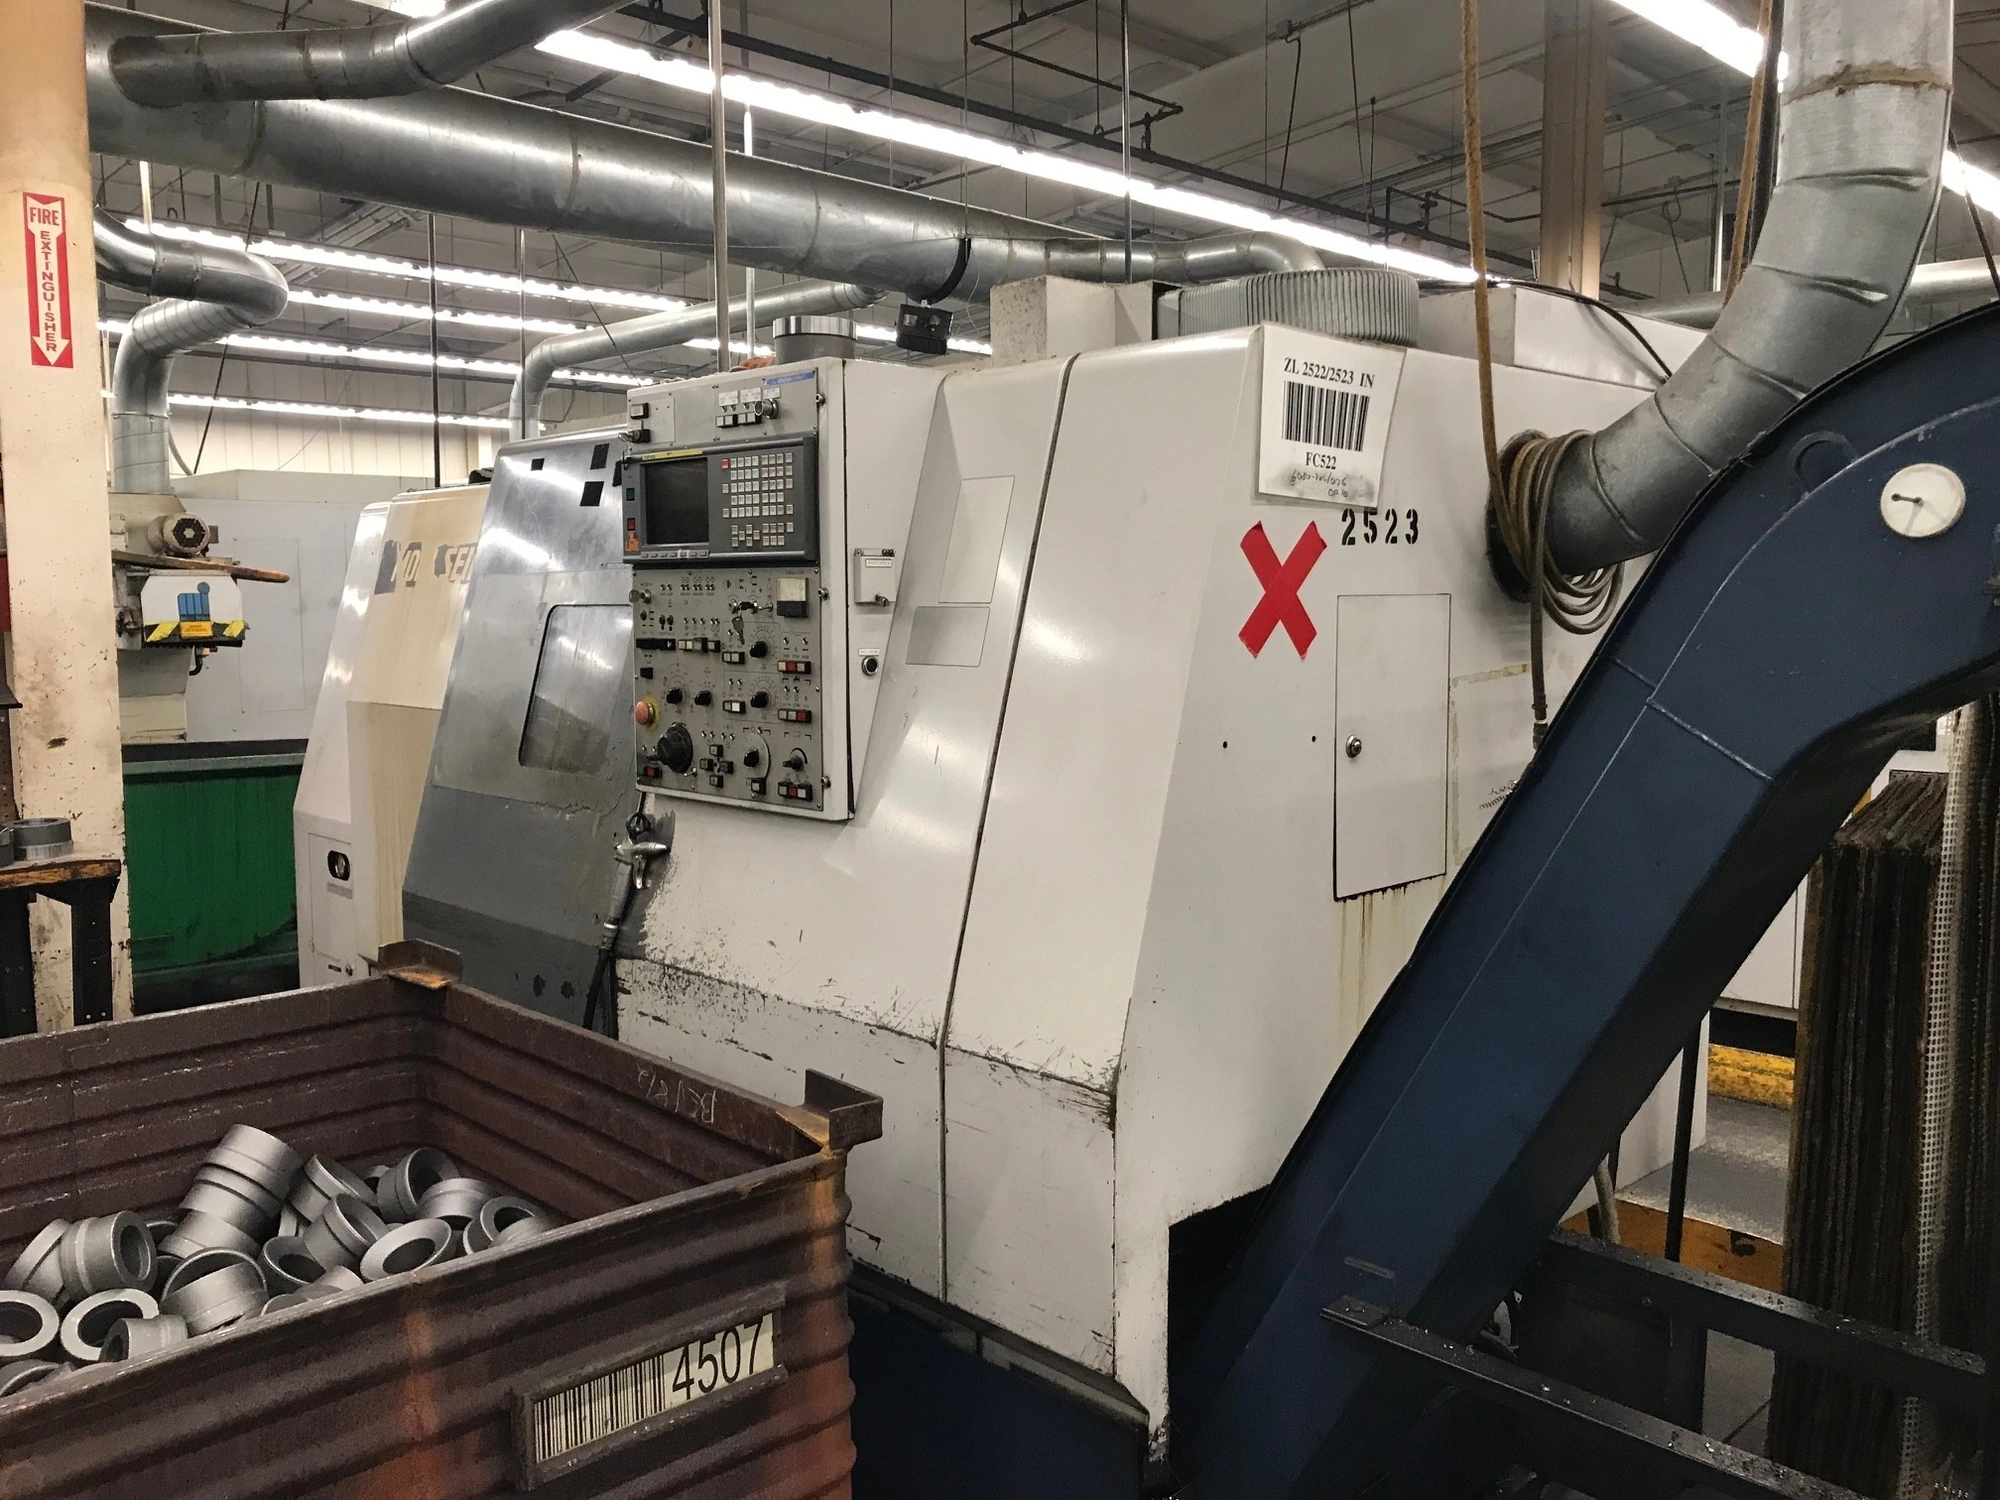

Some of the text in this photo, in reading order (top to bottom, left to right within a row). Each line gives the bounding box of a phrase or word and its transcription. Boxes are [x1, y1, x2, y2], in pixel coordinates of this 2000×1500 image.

[29, 207, 60, 226] FIRE
[40, 230, 58, 352] EXTINGUISHER
[1283, 357, 1375, 389] ZL 2522/2523 IN
[1305, 452, 1337, 470] FC522
[1341, 508, 1419, 546] 2523
[672, 1315, 764, 1400] 4507
